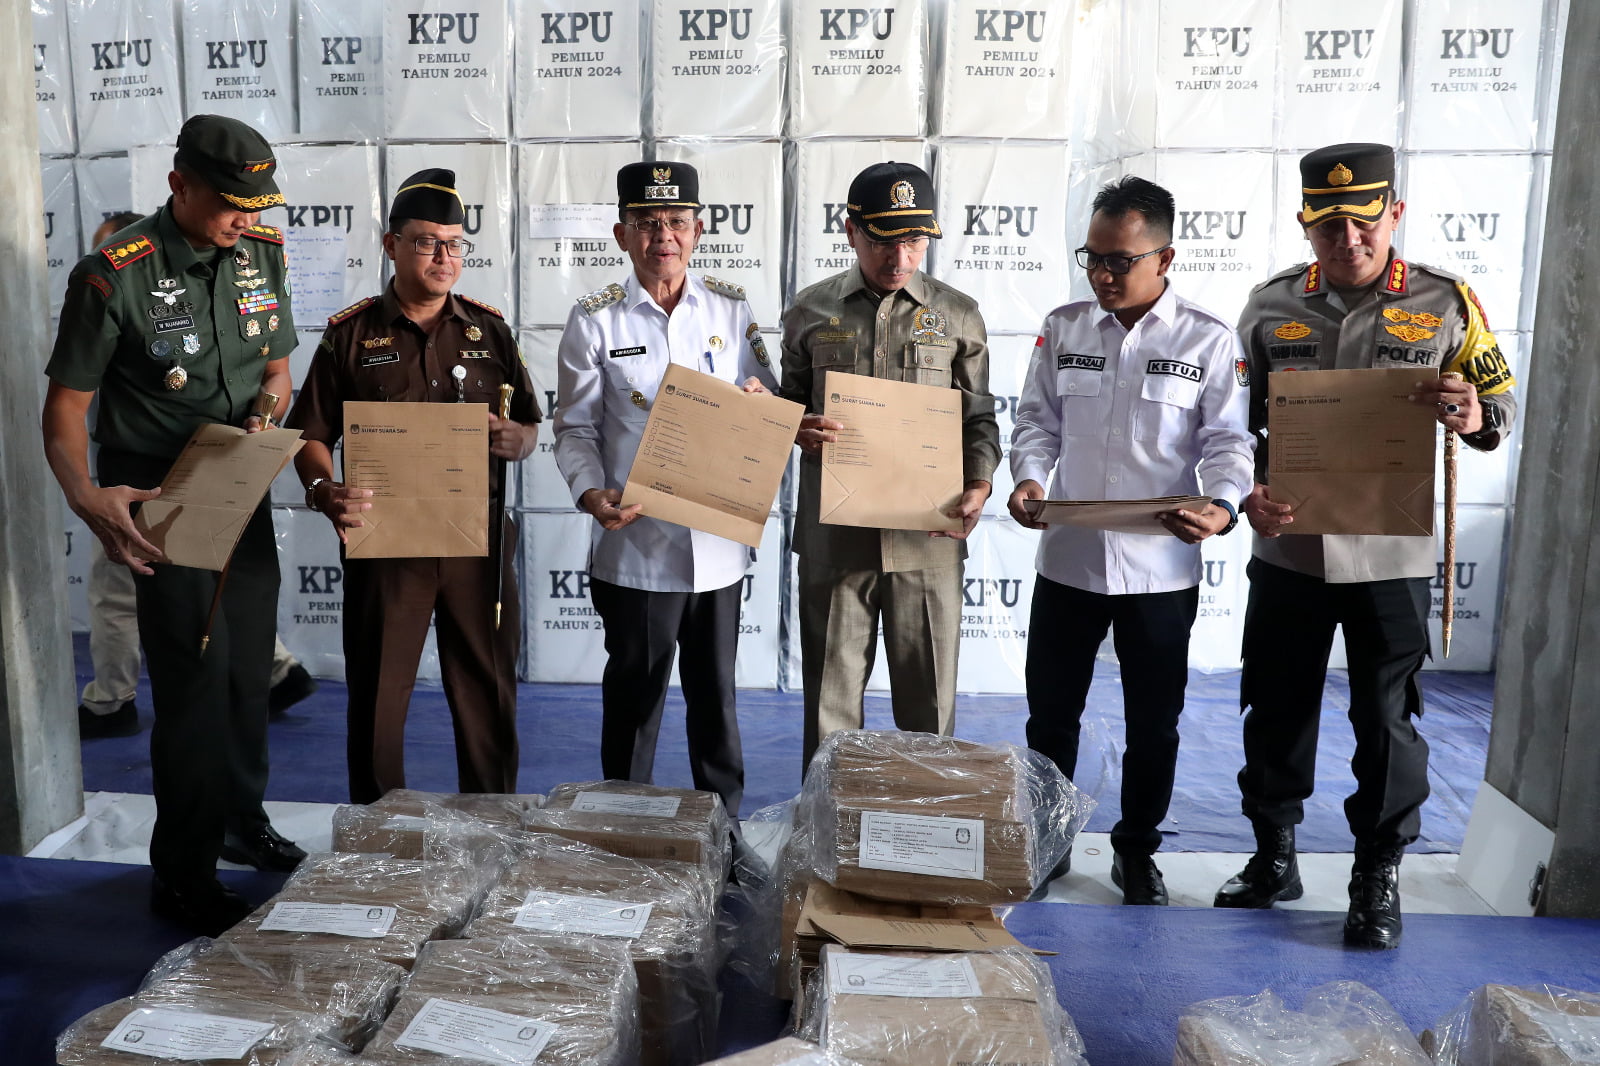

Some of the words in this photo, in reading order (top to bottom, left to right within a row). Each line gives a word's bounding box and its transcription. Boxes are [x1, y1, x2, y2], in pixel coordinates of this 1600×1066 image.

[408, 13, 479, 45] KPU
[541, 11, 613, 44] KPU
[679, 8, 753, 41] KPU
[820, 8, 895, 41] KPU
[975, 9, 1046, 43] KPU
[1184, 27, 1252, 58] KPU
[1304, 29, 1375, 60] KPU
[1440, 28, 1514, 59] KPU
[91, 39, 152, 70] KPU
[206, 39, 268, 69] KPU
[418, 53, 471, 63] PEMILU
[551, 51, 605, 63] PEMILU
[689, 50, 743, 61] PEMILU
[829, 49, 884, 60] PEMILU
[983, 50, 1038, 62] PEMILU
[402, 69, 449, 79] TAHUN
[454, 68, 488, 79] 2024
[536, 67, 583, 79] TAHUN
[588, 66, 623, 77] 2024
[672, 65, 722, 76] TAHUN
[726, 64, 761, 75] 2024
[812, 65, 862, 76] TAHUN
[867, 64, 902, 75] 2024
[965, 65, 1014, 77] TAHUN
[1020, 67, 1056, 78] 2024
[1192, 65, 1242, 76] PEMILU
[1448, 68, 1502, 78] PEMILU
[103, 75, 148, 87] PEMILU
[216, 75, 261, 86] PEMILU
[1175, 80, 1221, 91] TAHUN
[1225, 80, 1259, 90] 2024
[316, 86, 359, 96] TAHUN
[1431, 83, 1478, 92] TAHUN
[36, 92, 56, 101] 024
[90, 90, 131, 101] TAHUN
[135, 87, 163, 98] 2024
[202, 90, 242, 100] TAHUN
[248, 88, 276, 98] 2024
[286, 205, 354, 234] KPU
[699, 204, 754, 235] PU
[964, 204, 1037, 237] KPU
[1178, 211, 1247, 240] KPU
[554, 242, 607, 253] PMILU
[972, 245, 1026, 256] PEMILU
[1187, 248, 1236, 258] PEMILU
[590, 257, 624, 267] 2024
[687, 258, 722, 269] AHUN
[727, 258, 762, 269] 2024
[815, 258, 857, 268] TAHU
[954, 259, 1004, 271] TAHUN
[1010, 261, 1043, 272] 2024
[1171, 262, 1216, 272] TAHUN
[1220, 262, 1252, 272] 2024
[1377, 345, 1437, 366] POLRI
[1151, 362, 1199, 380] KETUA
[298, 566, 343, 594] KP
[549, 570, 591, 599] KP
[308, 602, 343, 611] PEMI
[1200, 608, 1231, 617] 2024
[294, 615, 338, 624] TAHUN
[544, 621, 589, 630] TAHUN
[960, 615, 1011, 625] PEMIU
[737, 625, 762, 634] 024
[960, 629, 988, 638] HUN
